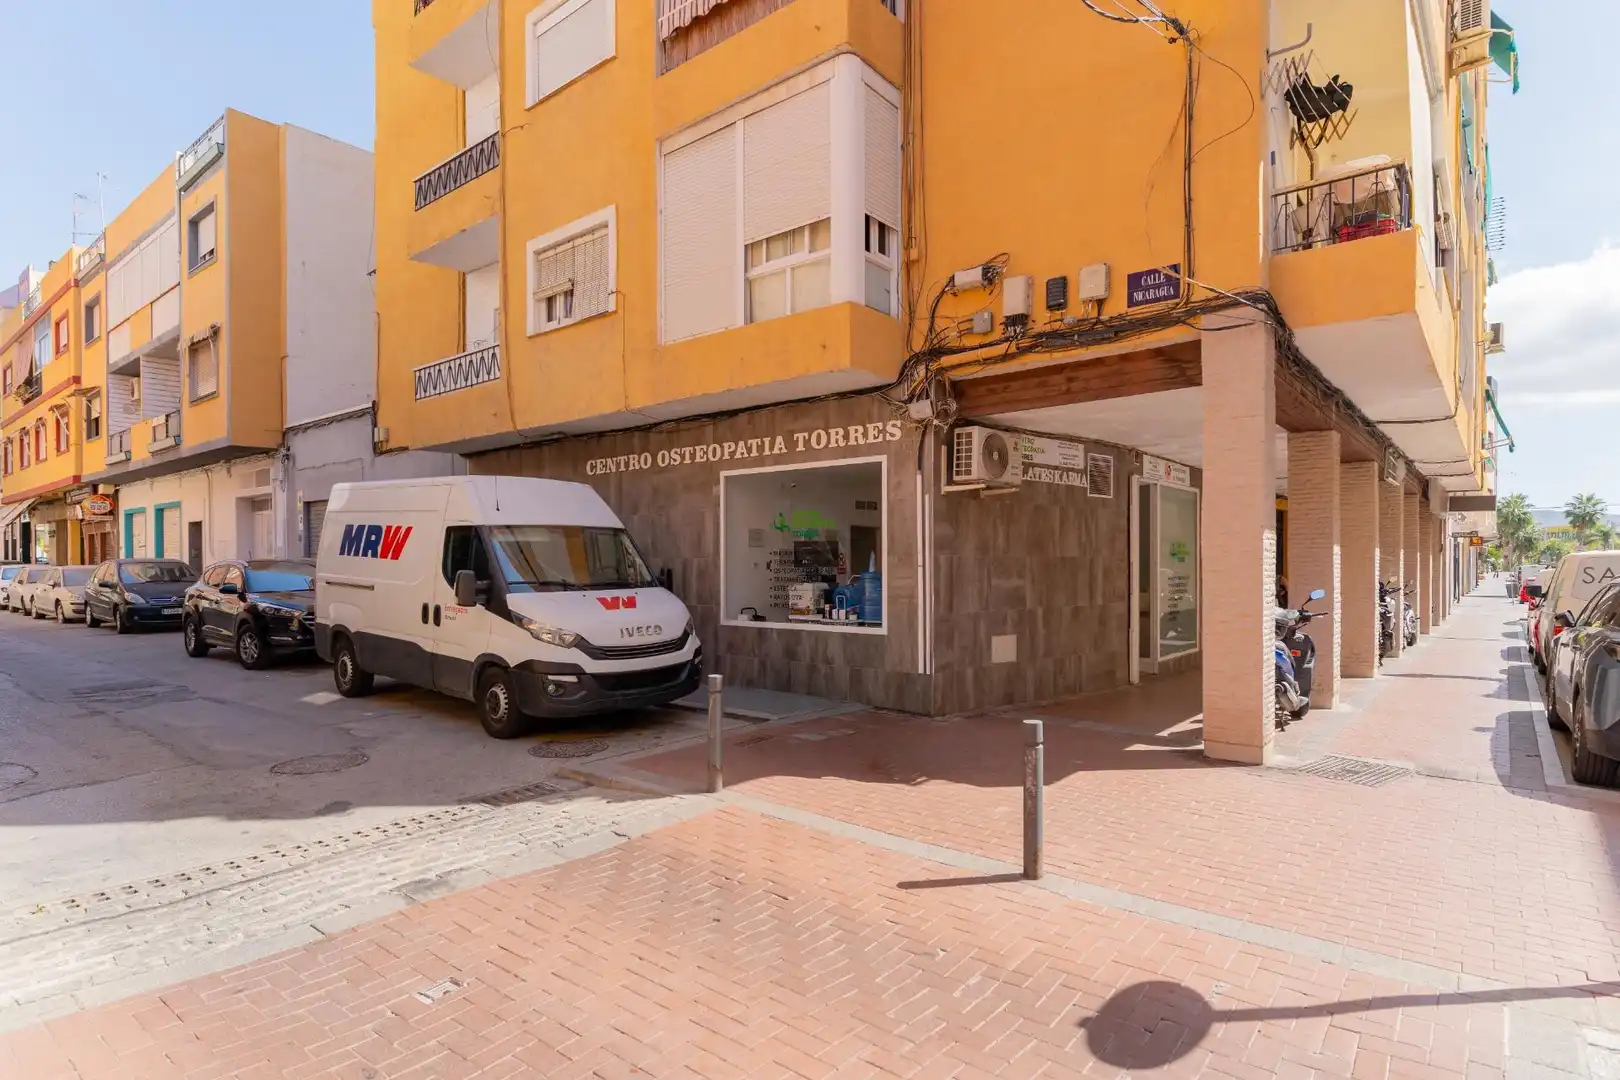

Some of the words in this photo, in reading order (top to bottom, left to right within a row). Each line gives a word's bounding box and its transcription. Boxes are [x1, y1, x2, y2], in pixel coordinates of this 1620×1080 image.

[1141, 272, 1166, 286] CALLE
[1133, 285, 1174, 302] NICARAGUA
[586, 452, 652, 476] CENTRO
[657, 435, 788, 468] OSTEOPATIA
[793, 420, 903, 452] TORRES
[338, 524, 413, 560] MRW
[620, 625, 662, 638] IVECO
